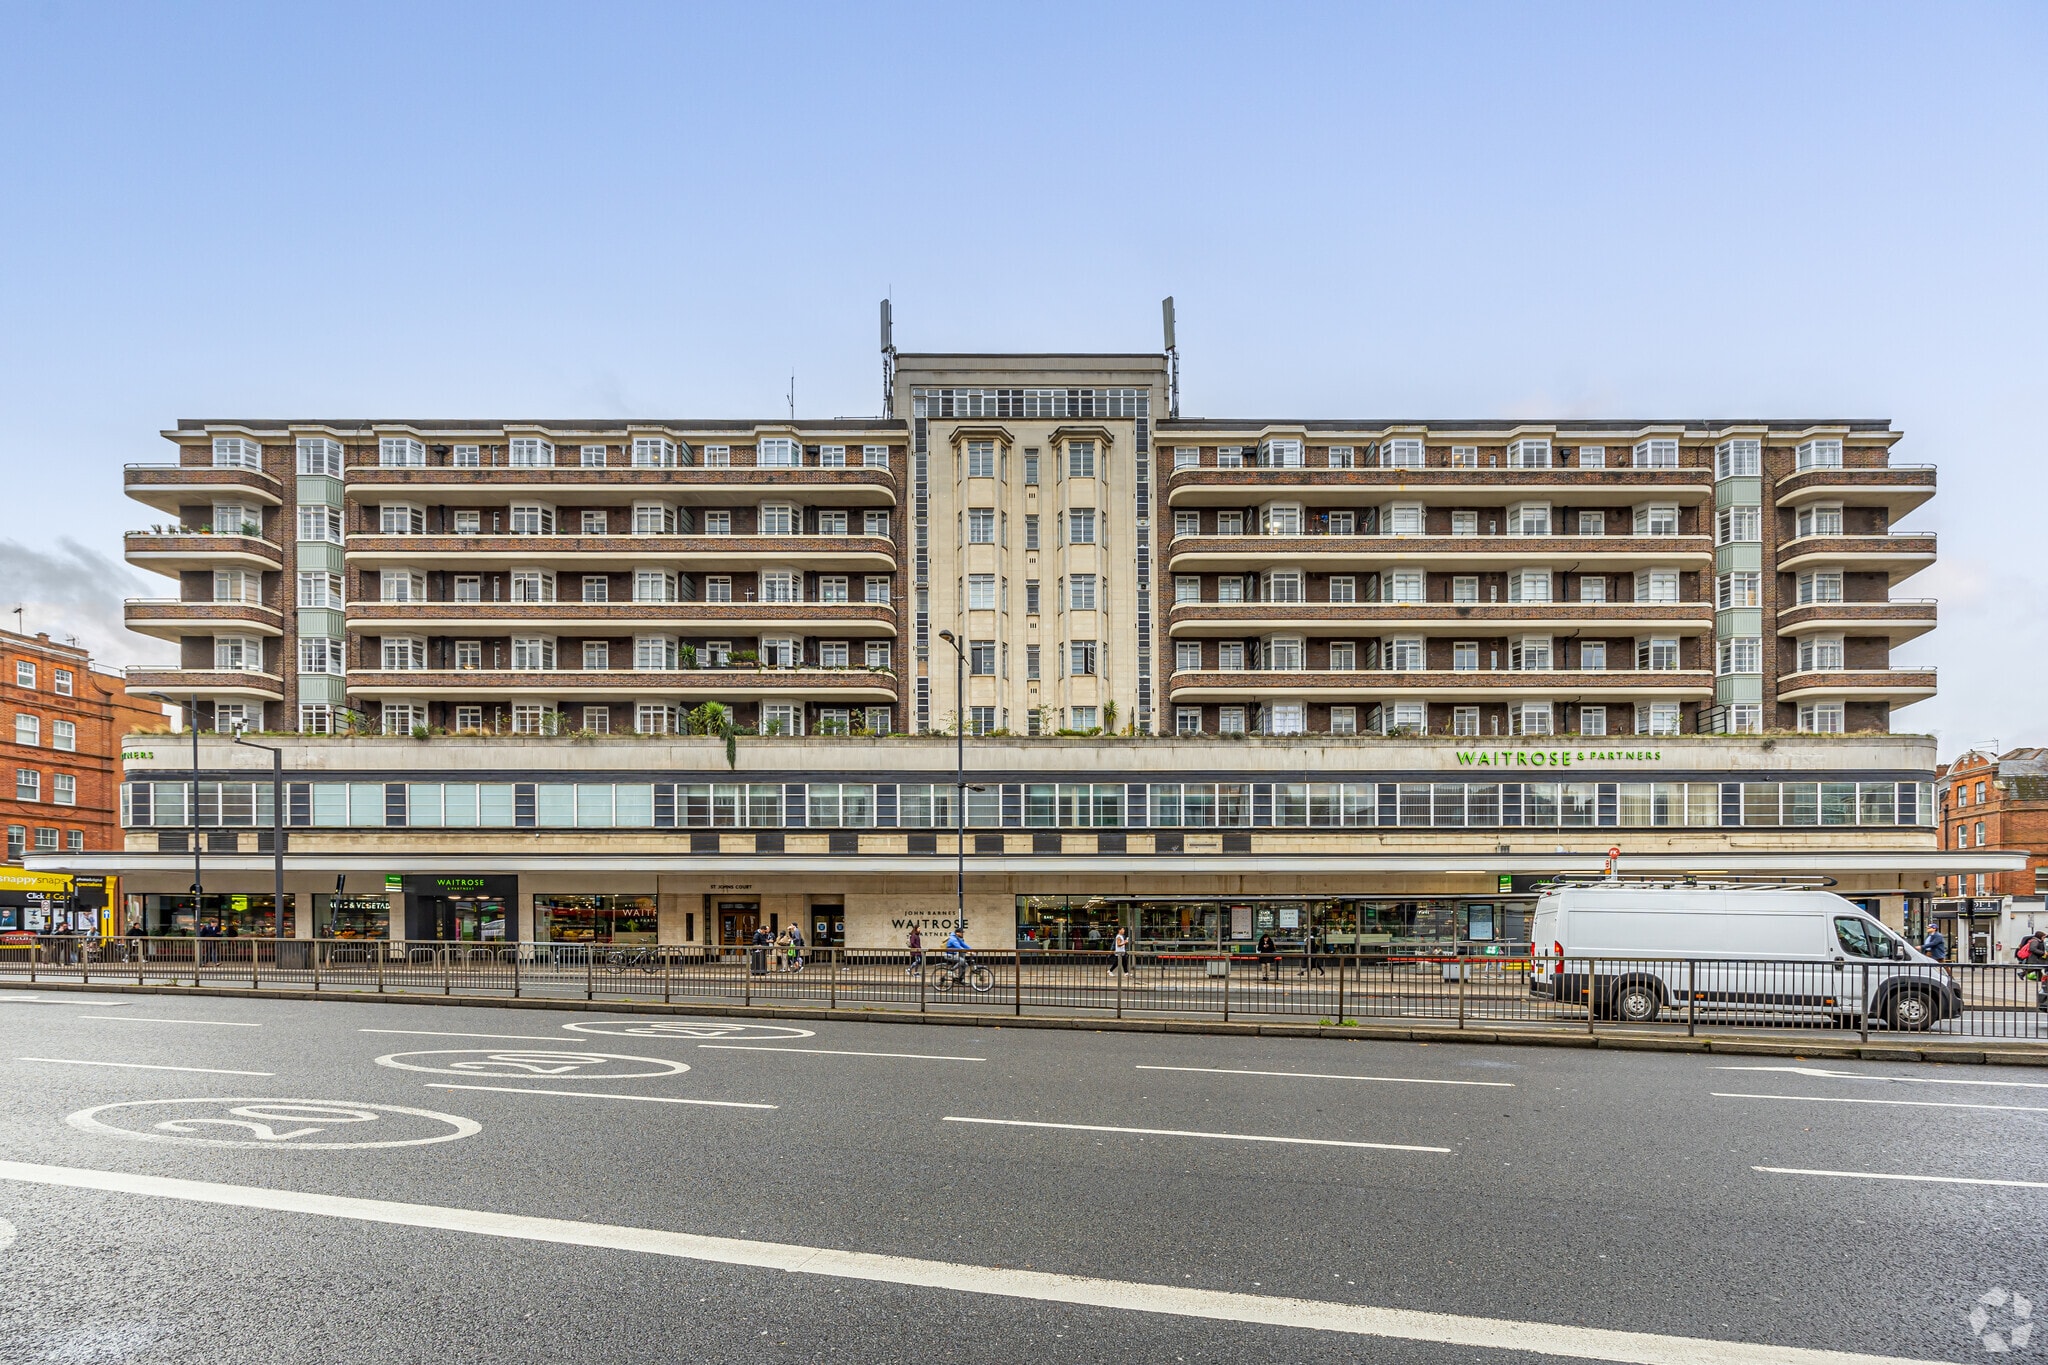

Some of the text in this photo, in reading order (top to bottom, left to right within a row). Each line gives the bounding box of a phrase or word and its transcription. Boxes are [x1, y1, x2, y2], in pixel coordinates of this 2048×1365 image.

[1456, 751, 1661, 766] WAITROSE & PARTNERS
[26, 892, 45, 900] Click
[892, 919, 969, 929] WAITROSE
[449, 1053, 608, 1074] 20
[154, 1105, 380, 1141] 20
